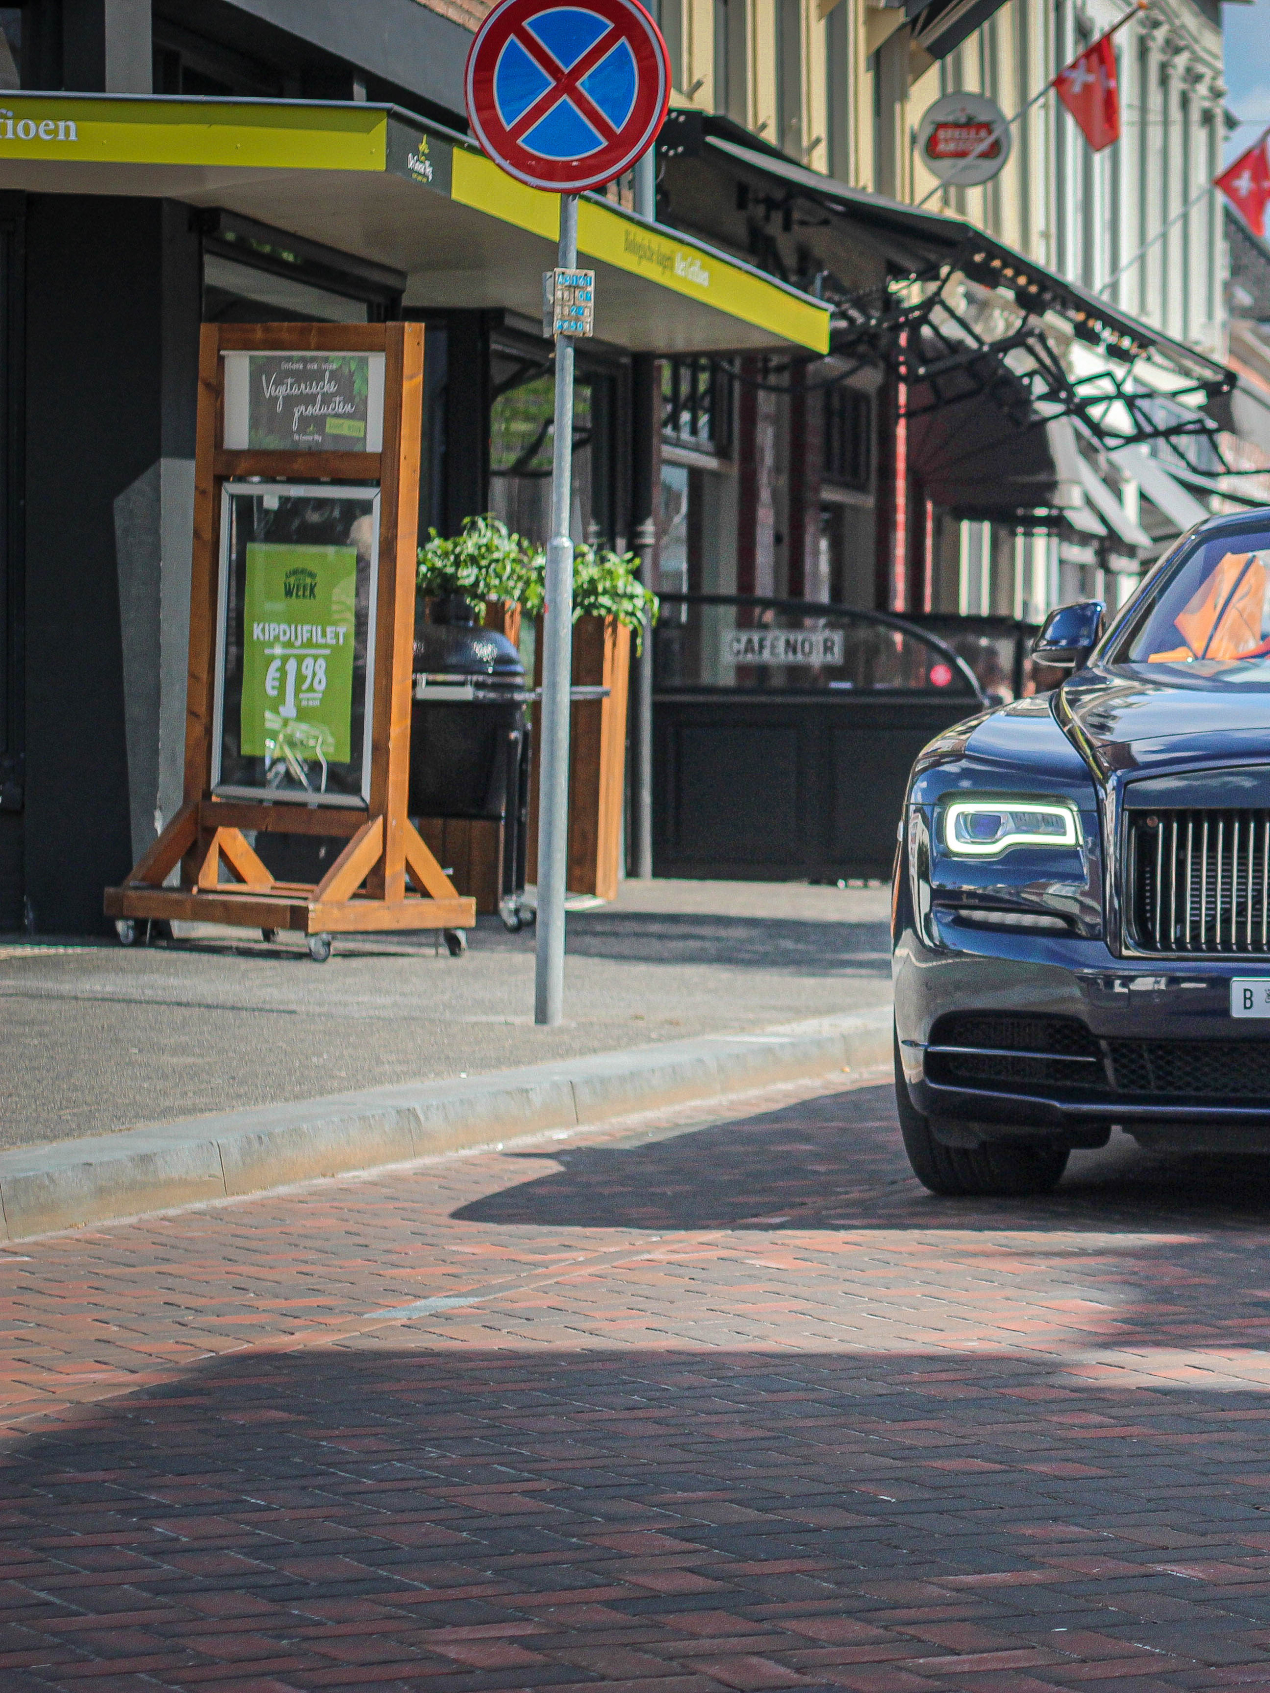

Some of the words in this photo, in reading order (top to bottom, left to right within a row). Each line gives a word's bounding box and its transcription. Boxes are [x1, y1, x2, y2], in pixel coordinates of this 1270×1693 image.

[938, 127, 989, 140] STELLA
[937, 141, 989, 152] ARTO
[262, 371, 339, 413] Vegetarische
[292, 393, 356, 432] producten
[284, 582, 317, 599] WEEK
[253, 621, 347, 646] KIPDIJFILET
[784, 637, 836, 656] NOR
[1243, 988, 1254, 1010] B
